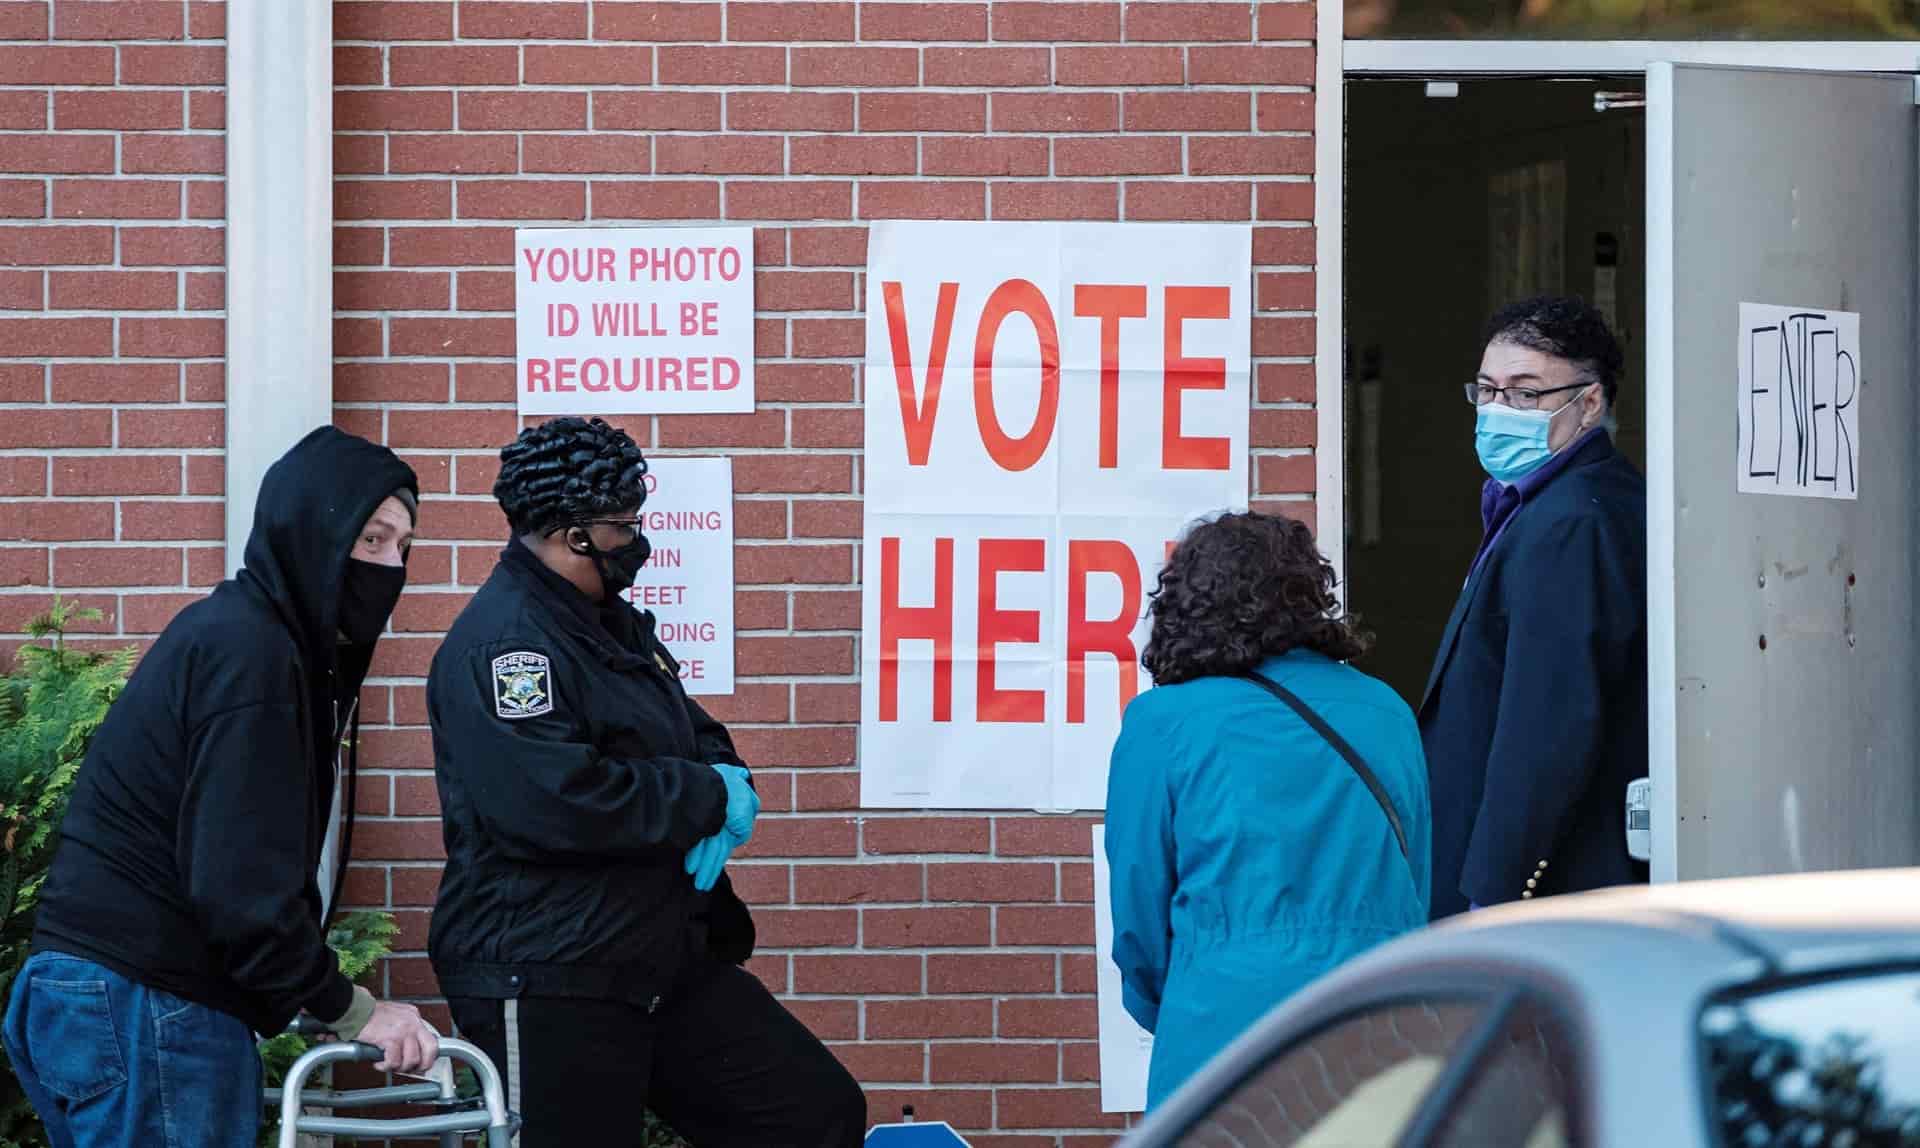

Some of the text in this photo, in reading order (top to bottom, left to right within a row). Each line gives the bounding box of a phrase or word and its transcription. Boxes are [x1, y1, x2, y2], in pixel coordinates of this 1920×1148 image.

[523, 246, 741, 283] YOUR PHOTO
[547, 302, 719, 337] ID WILL BE
[526, 357, 741, 393] REQUIRED
[881, 278, 1231, 472] VOTE
[1750, 313, 1856, 493] ENTER
[641, 474, 657, 494] O
[641, 511, 721, 530] IGNING
[643, 549, 681, 568] HIN
[629, 585, 687, 605] FEET
[660, 623, 716, 642] DING
[879, 537, 1177, 724] HER
[495, 655, 546, 668] SHERIFF
[678, 659, 705, 679] CE
